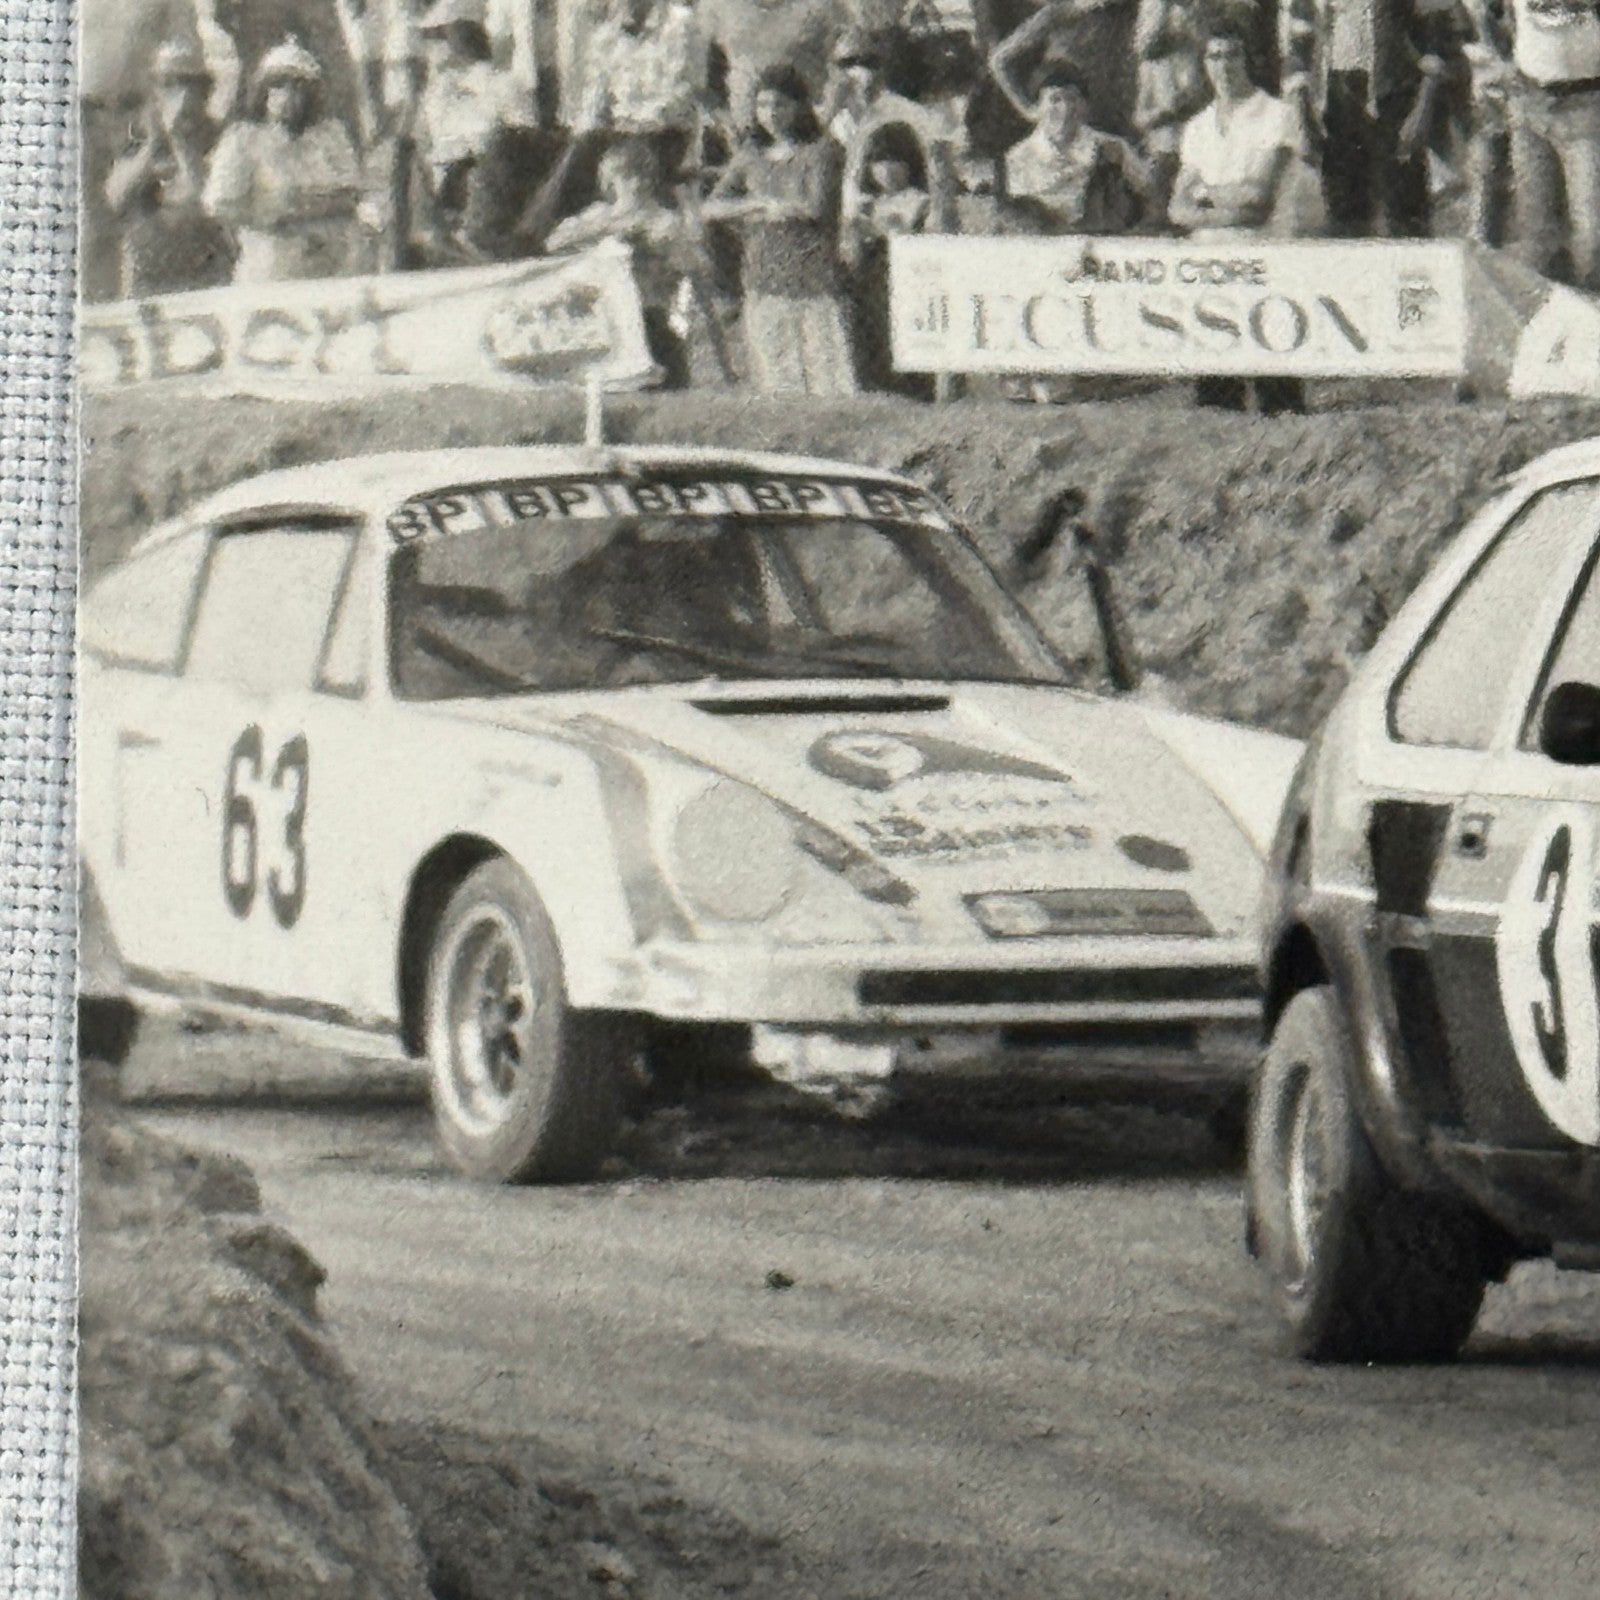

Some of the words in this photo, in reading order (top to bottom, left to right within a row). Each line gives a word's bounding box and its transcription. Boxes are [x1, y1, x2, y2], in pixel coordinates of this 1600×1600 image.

[386, 499, 467, 544] BP
[507, 487, 590, 520] BP
[631, 484, 708, 515] BP
[751, 484, 827, 512] BP
[222, 723, 310, 931] 63
[1531, 823, 1573, 1083] 3
